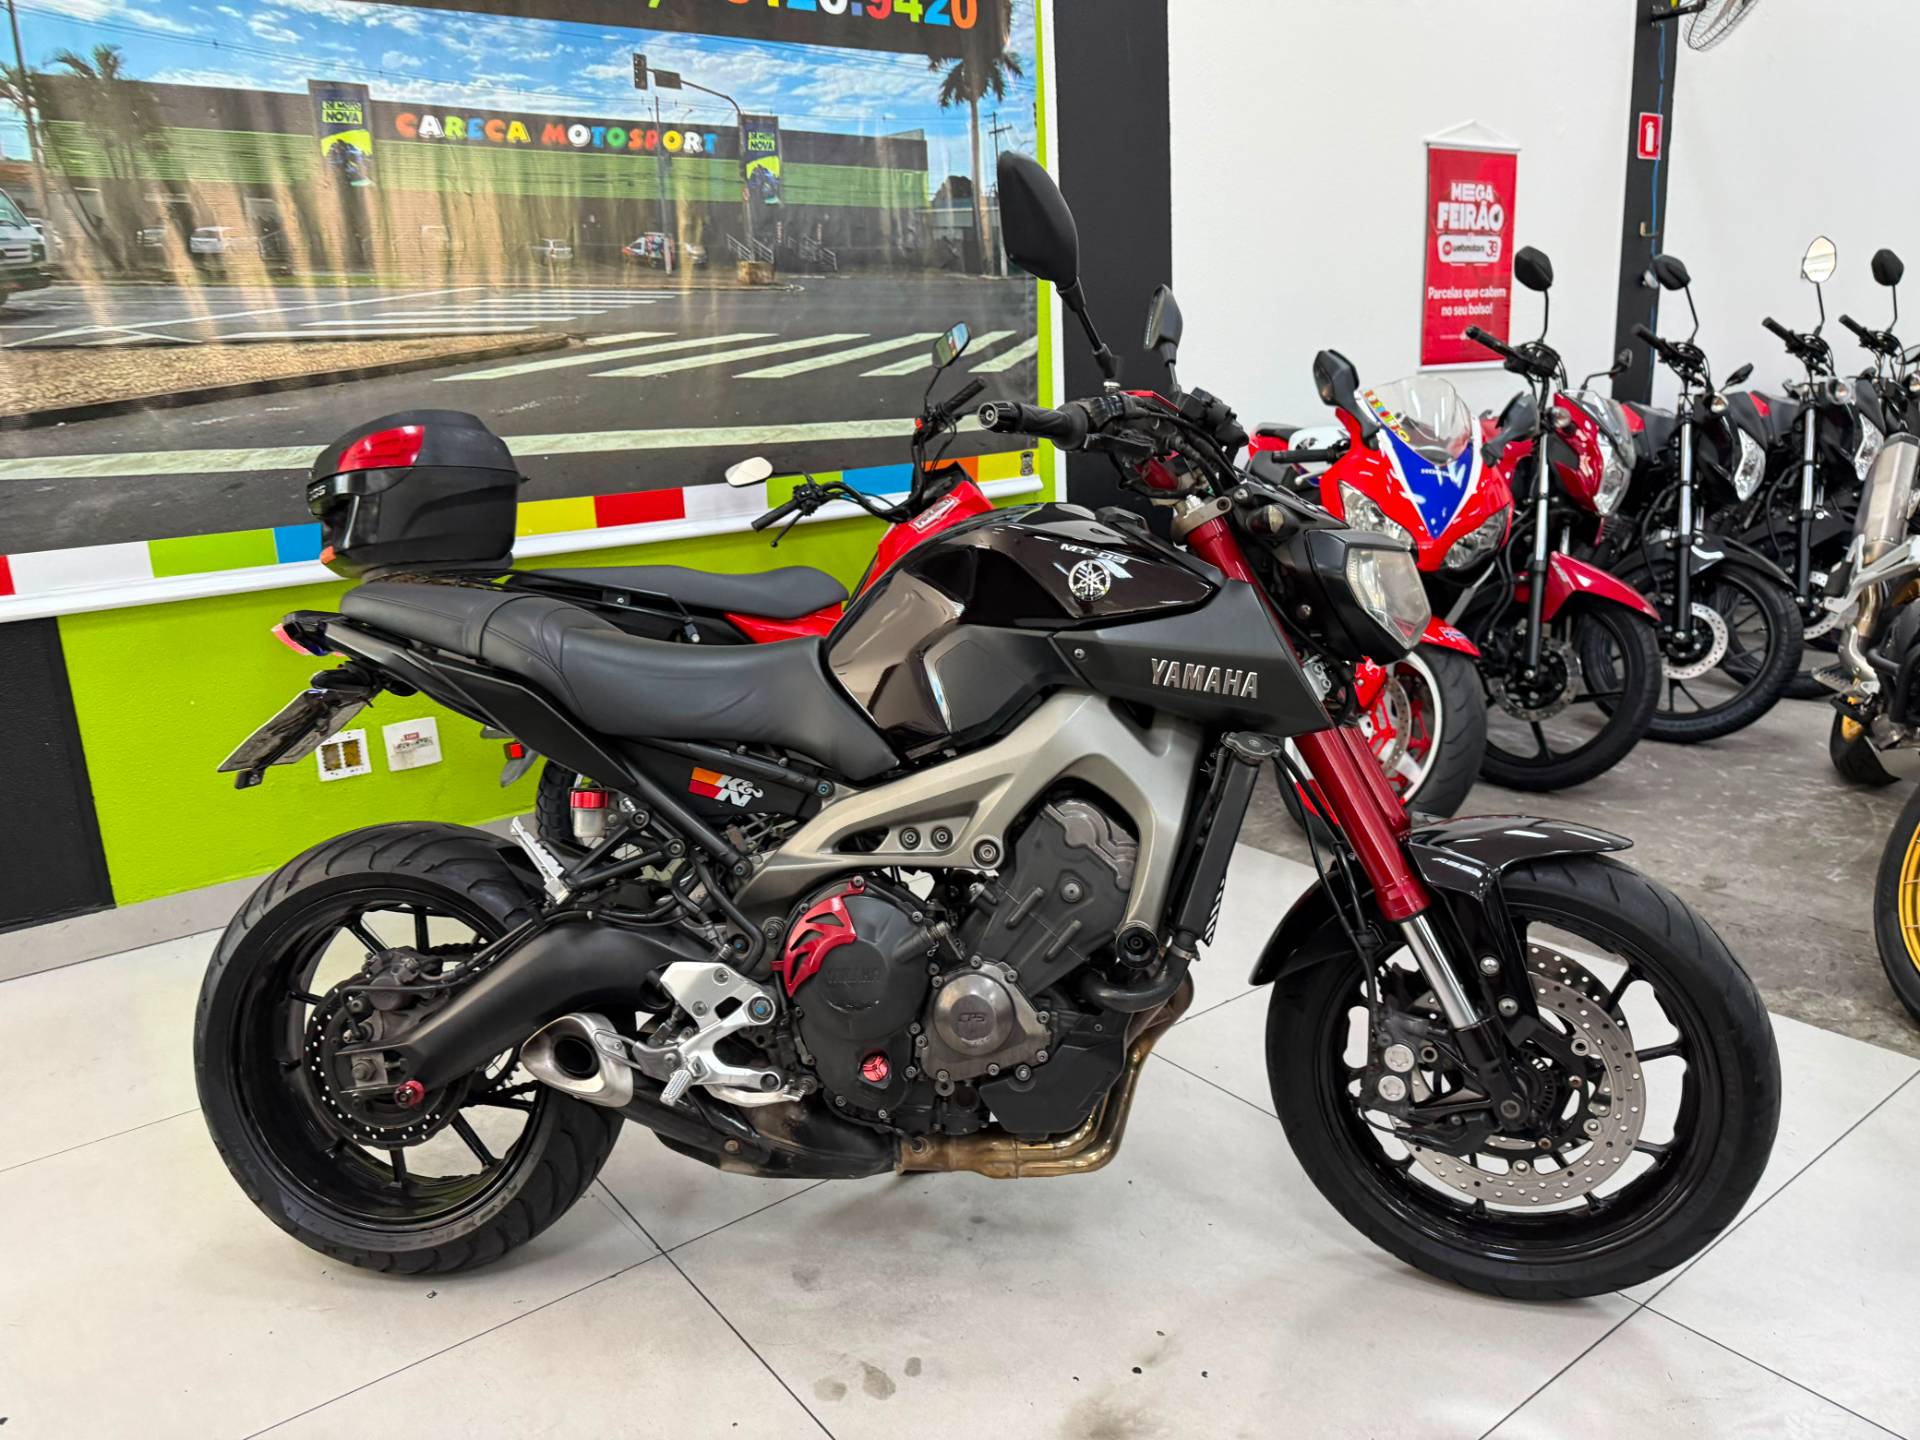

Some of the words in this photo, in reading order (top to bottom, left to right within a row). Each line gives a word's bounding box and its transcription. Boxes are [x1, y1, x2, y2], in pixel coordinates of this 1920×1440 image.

[395, 112, 532, 143] CARECA
[541, 122, 718, 154] MOTOSPORT
[1451, 182, 1494, 202] MEGA
[1437, 200, 1504, 231] FEIRÃO
[1428, 286, 1462, 299] Parcelas
[1463, 288, 1479, 301] que
[1480, 285, 1506, 298] cabem
[1441, 306, 1453, 316] no
[1454, 305, 1467, 316] seu
[1468, 302, 1494, 315] bolso!
[1060, 543, 1129, 565] MT-09
[1151, 658, 1258, 699] YAMAHA
[714, 774, 764, 807] K&N
